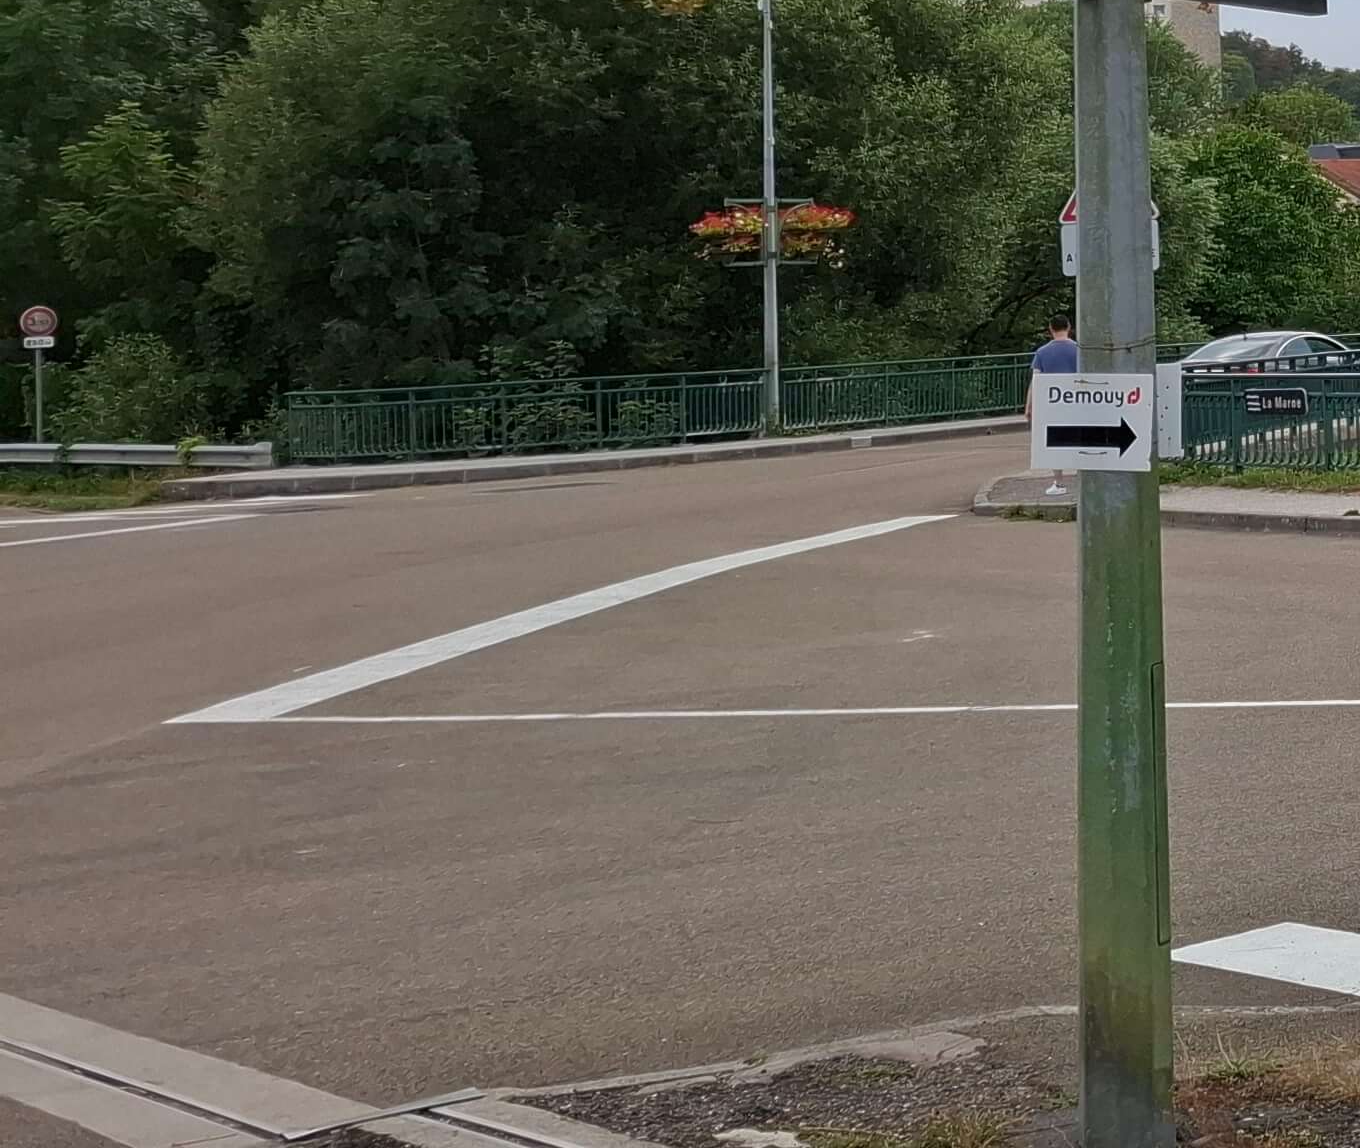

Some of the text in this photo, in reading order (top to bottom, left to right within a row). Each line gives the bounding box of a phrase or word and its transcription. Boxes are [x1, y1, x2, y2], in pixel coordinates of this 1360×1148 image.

[1048, 386, 1124, 407] Demouy
[1262, 396, 1302, 409] La Marne
